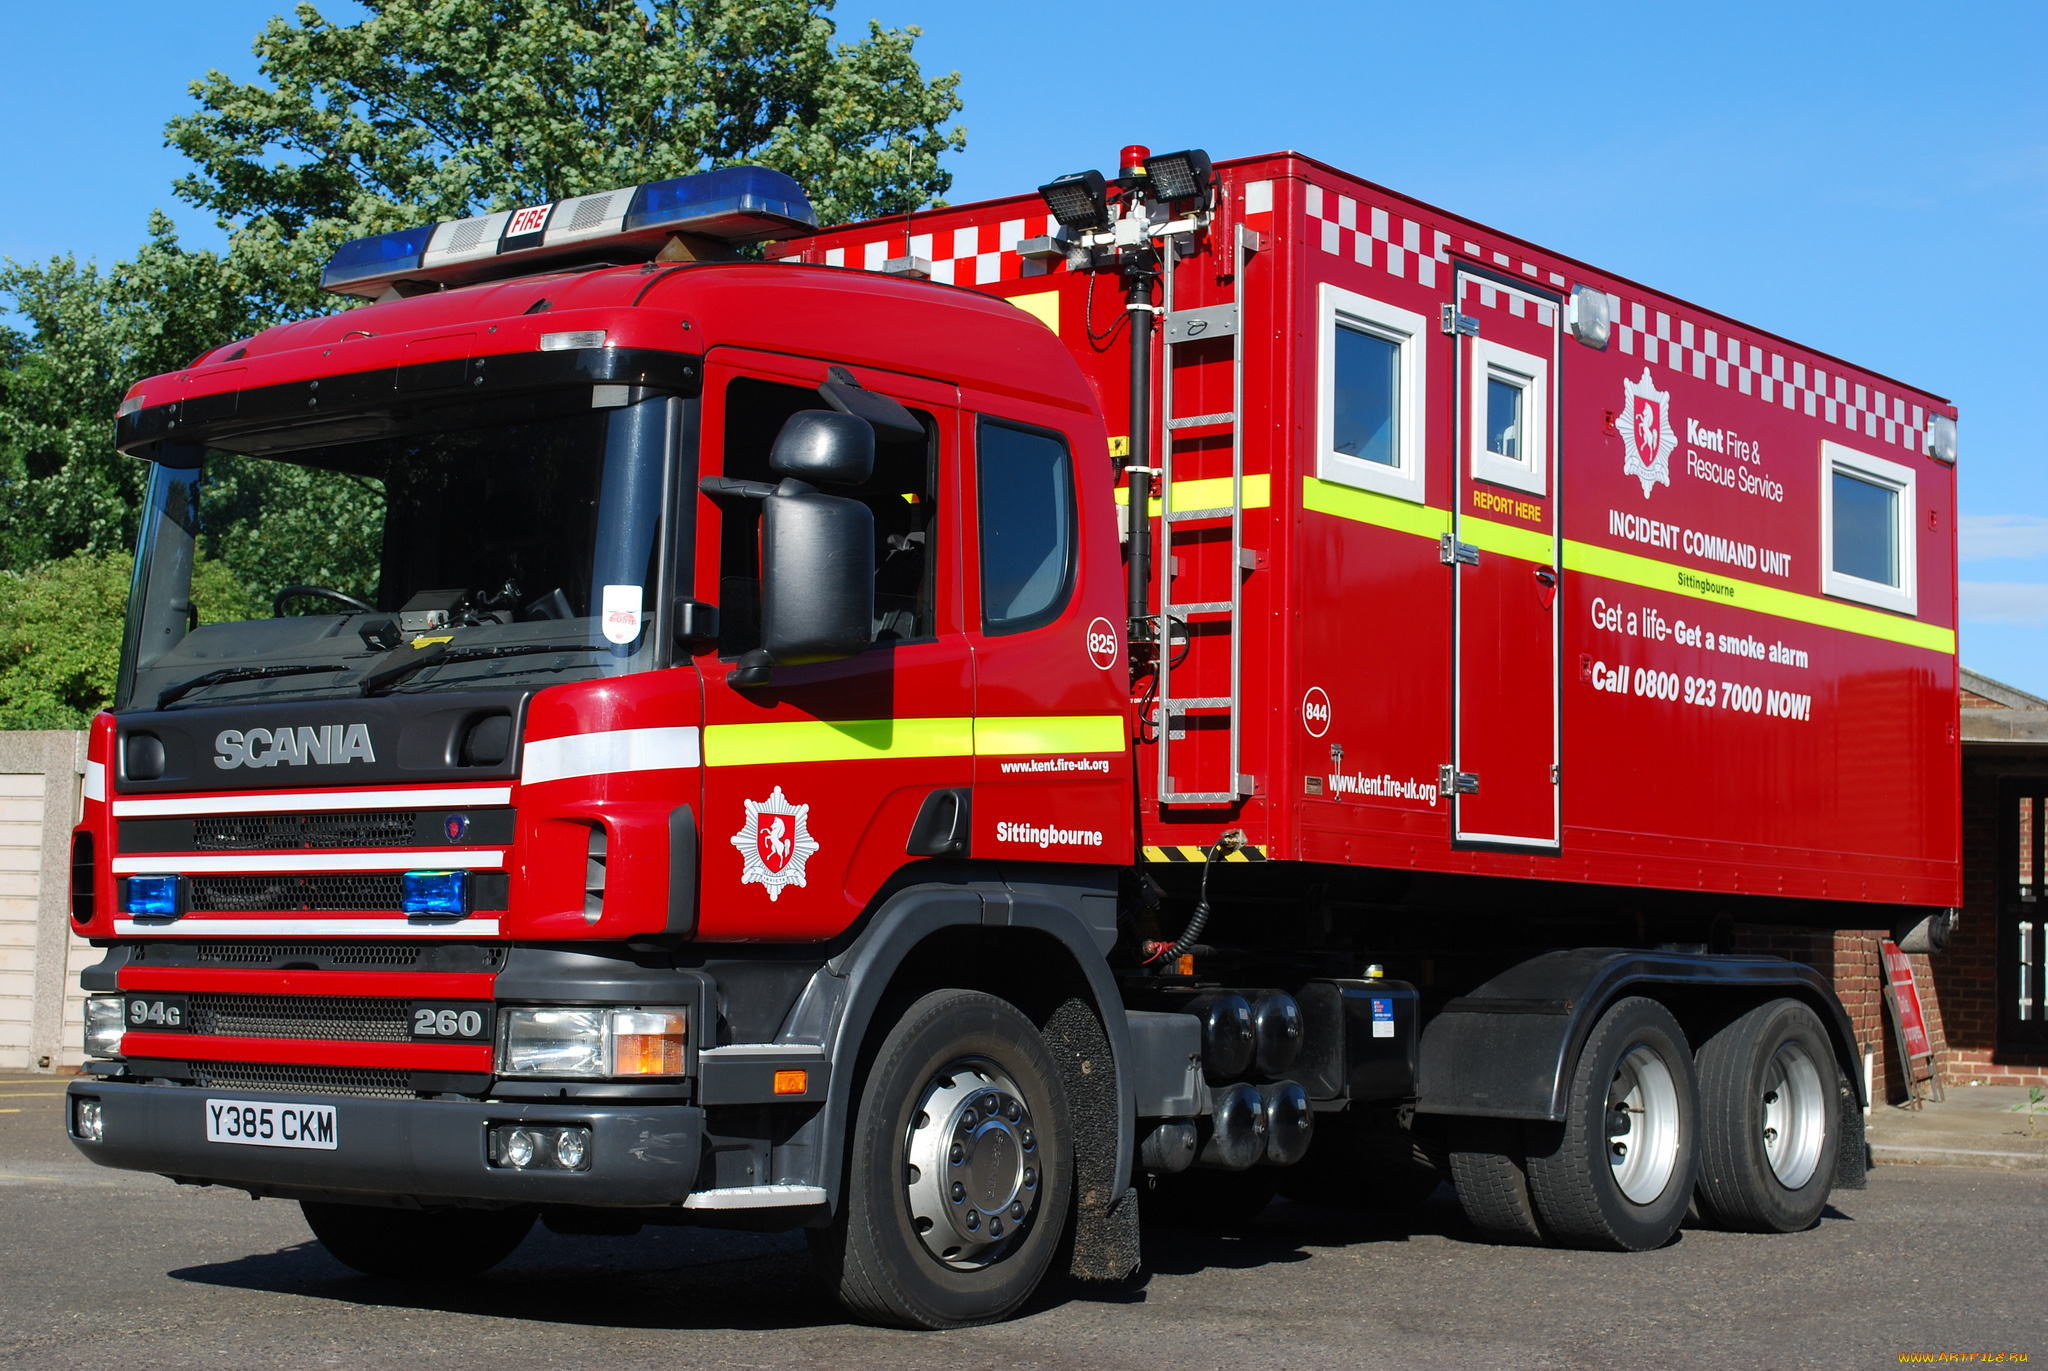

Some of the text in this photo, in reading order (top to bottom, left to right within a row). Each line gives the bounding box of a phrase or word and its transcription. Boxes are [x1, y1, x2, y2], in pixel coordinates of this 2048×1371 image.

[511, 208, 548, 233] FIRE
[1687, 417, 1761, 465] Kent Fire &
[1687, 449, 1783, 503] Rescue Service
[1473, 490, 1541, 522] REPORT HERE
[1609, 509, 1792, 578] INCIDENT COMMAND UNIT
[1677, 572, 1735, 597] Sittingbourne
[1089, 633, 1115, 654] 825
[1591, 597, 1623, 633] Get
[1626, 611, 1637, 636] a
[1705, 632, 1715, 650] a
[1718, 635, 1765, 660] smoke
[1768, 640, 1809, 669] alarm
[1592, 661, 1812, 722] Call 0800 923 7000 NOW!
[1306, 702, 1327, 721] 844
[214, 723, 376, 770] SCANIA
[1001, 758, 1110, 774] www.kent.fire-uk.org
[1328, 771, 1437, 807] www.kent.fire-uk.org
[996, 821, 1103, 849] Sittingbourne
[130, 1001, 180, 1026] 94G
[414, 1008, 482, 1037] 260
[210, 1104, 334, 1143] Y385 CKM
